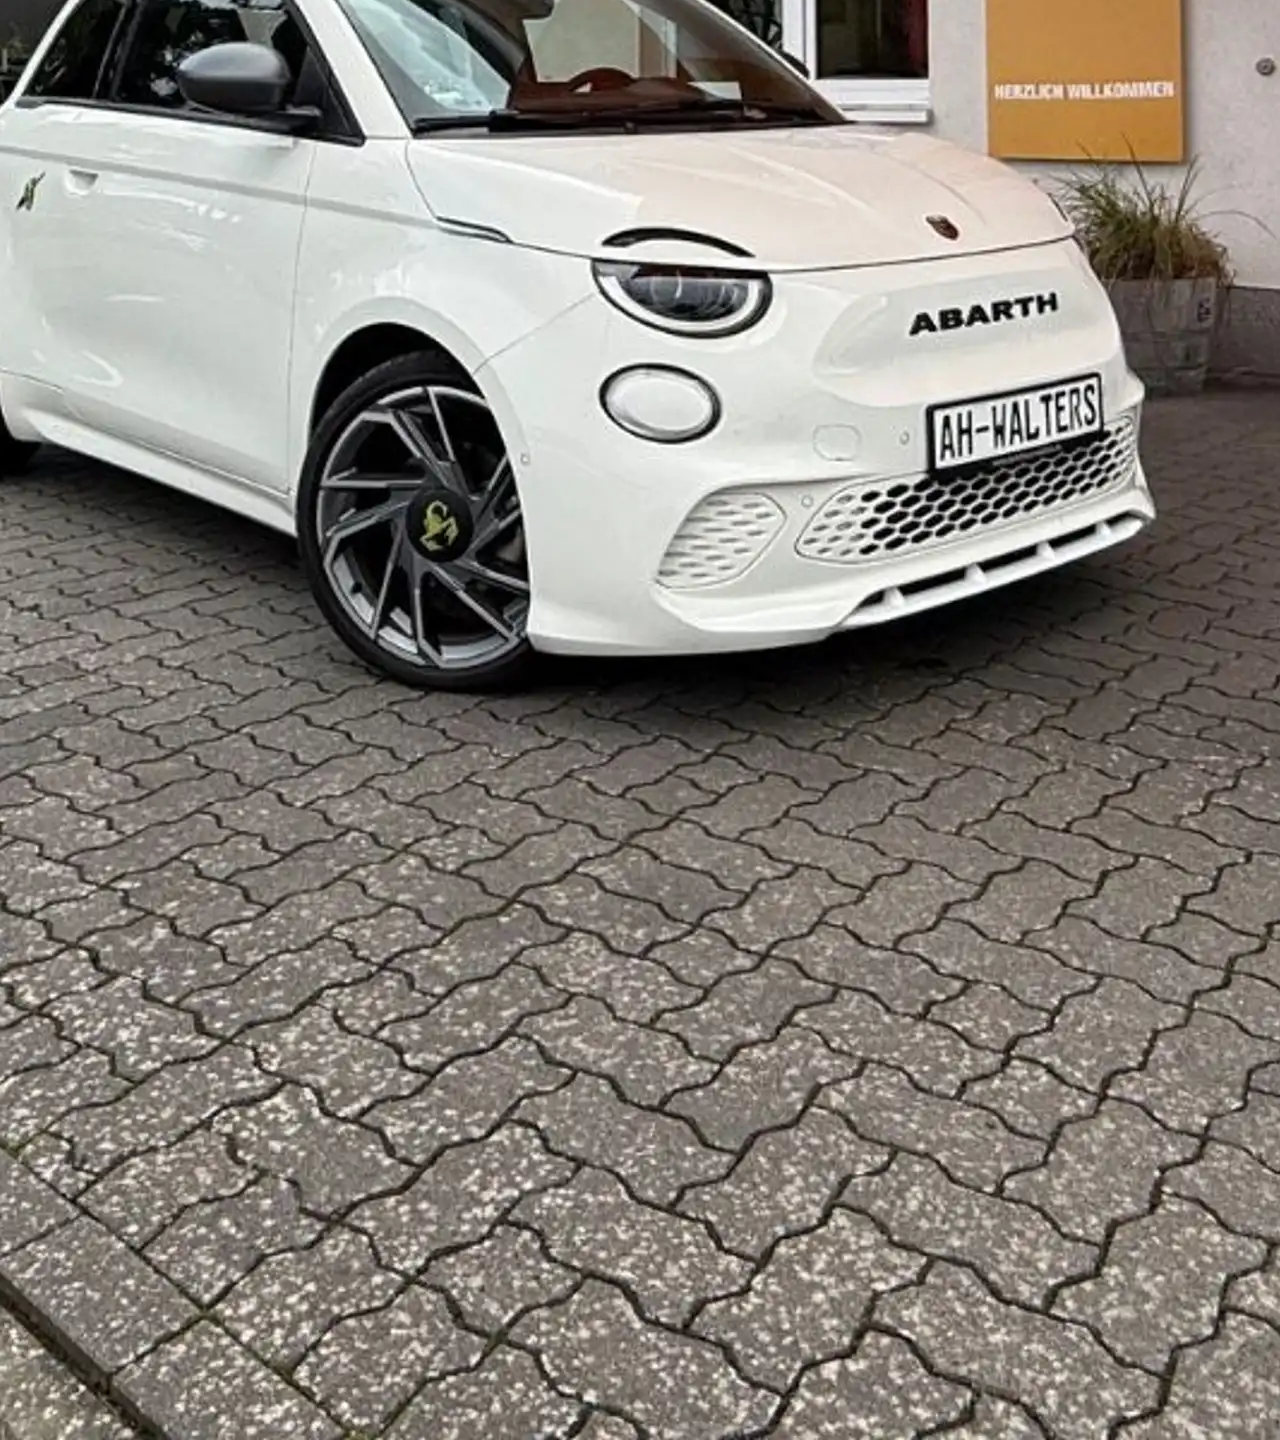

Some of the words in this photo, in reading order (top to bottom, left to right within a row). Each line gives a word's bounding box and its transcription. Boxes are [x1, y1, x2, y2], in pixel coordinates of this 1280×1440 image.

[994, 83, 1063, 100] HERZLICH
[1066, 80, 1175, 99] WILLKOMMEN
[908, 291, 1059, 337] ABARTH
[939, 383, 1097, 462] AH-WALTERS
